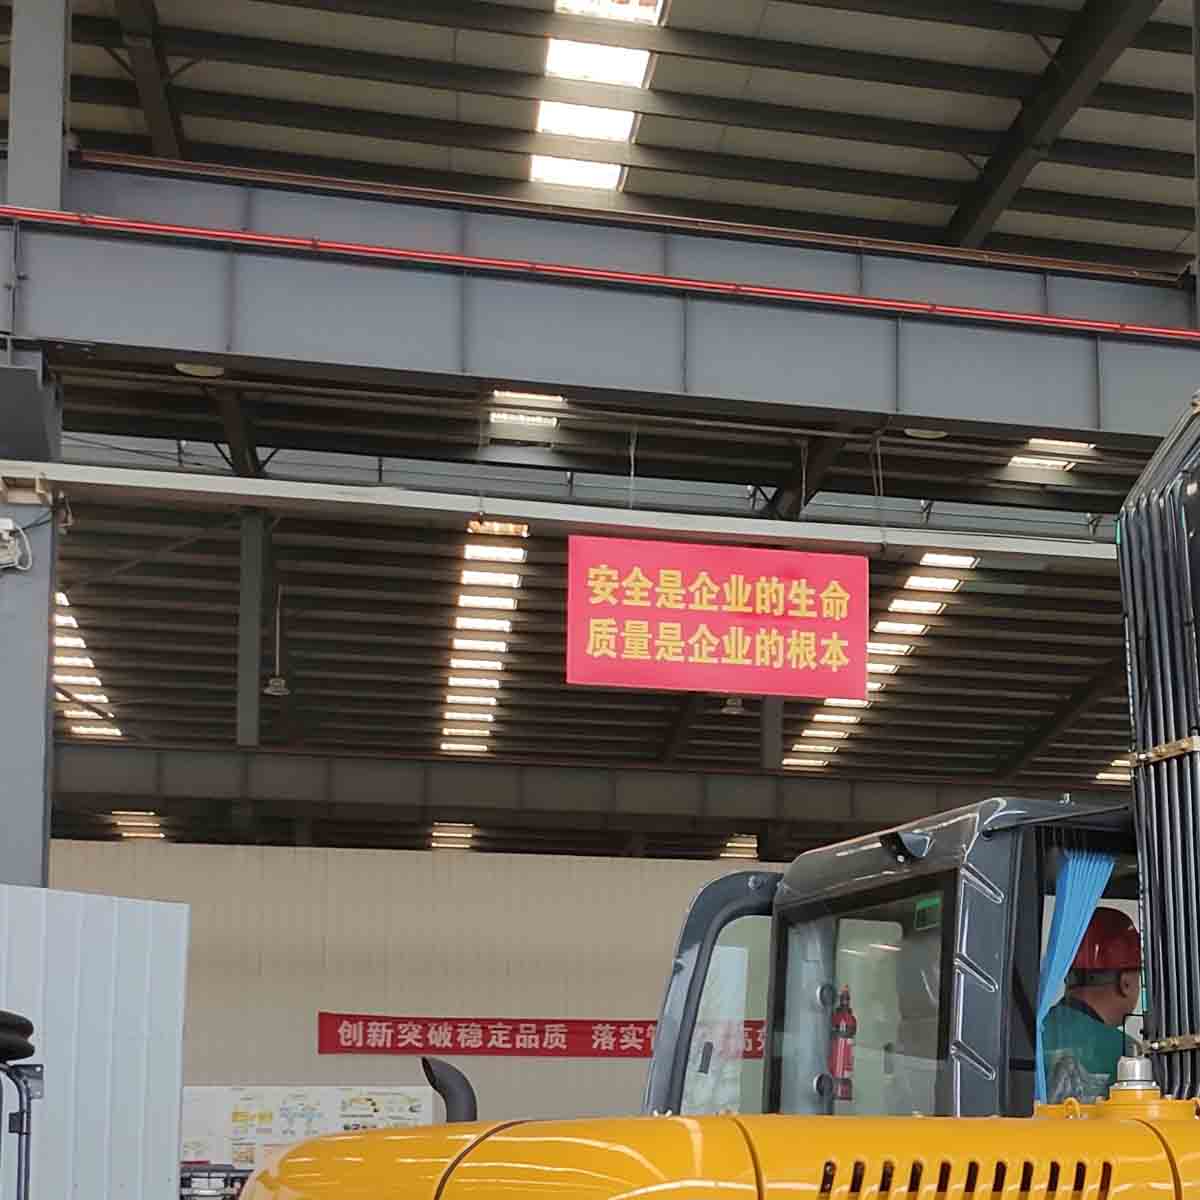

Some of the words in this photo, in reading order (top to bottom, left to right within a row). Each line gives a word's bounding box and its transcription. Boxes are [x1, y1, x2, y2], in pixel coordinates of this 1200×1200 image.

[586, 564, 851, 621] 安全是企业的生命
[586, 617, 850, 672] 质量是企业的根本
[337, 1019, 569, 1052] 创新突破稳定品质
